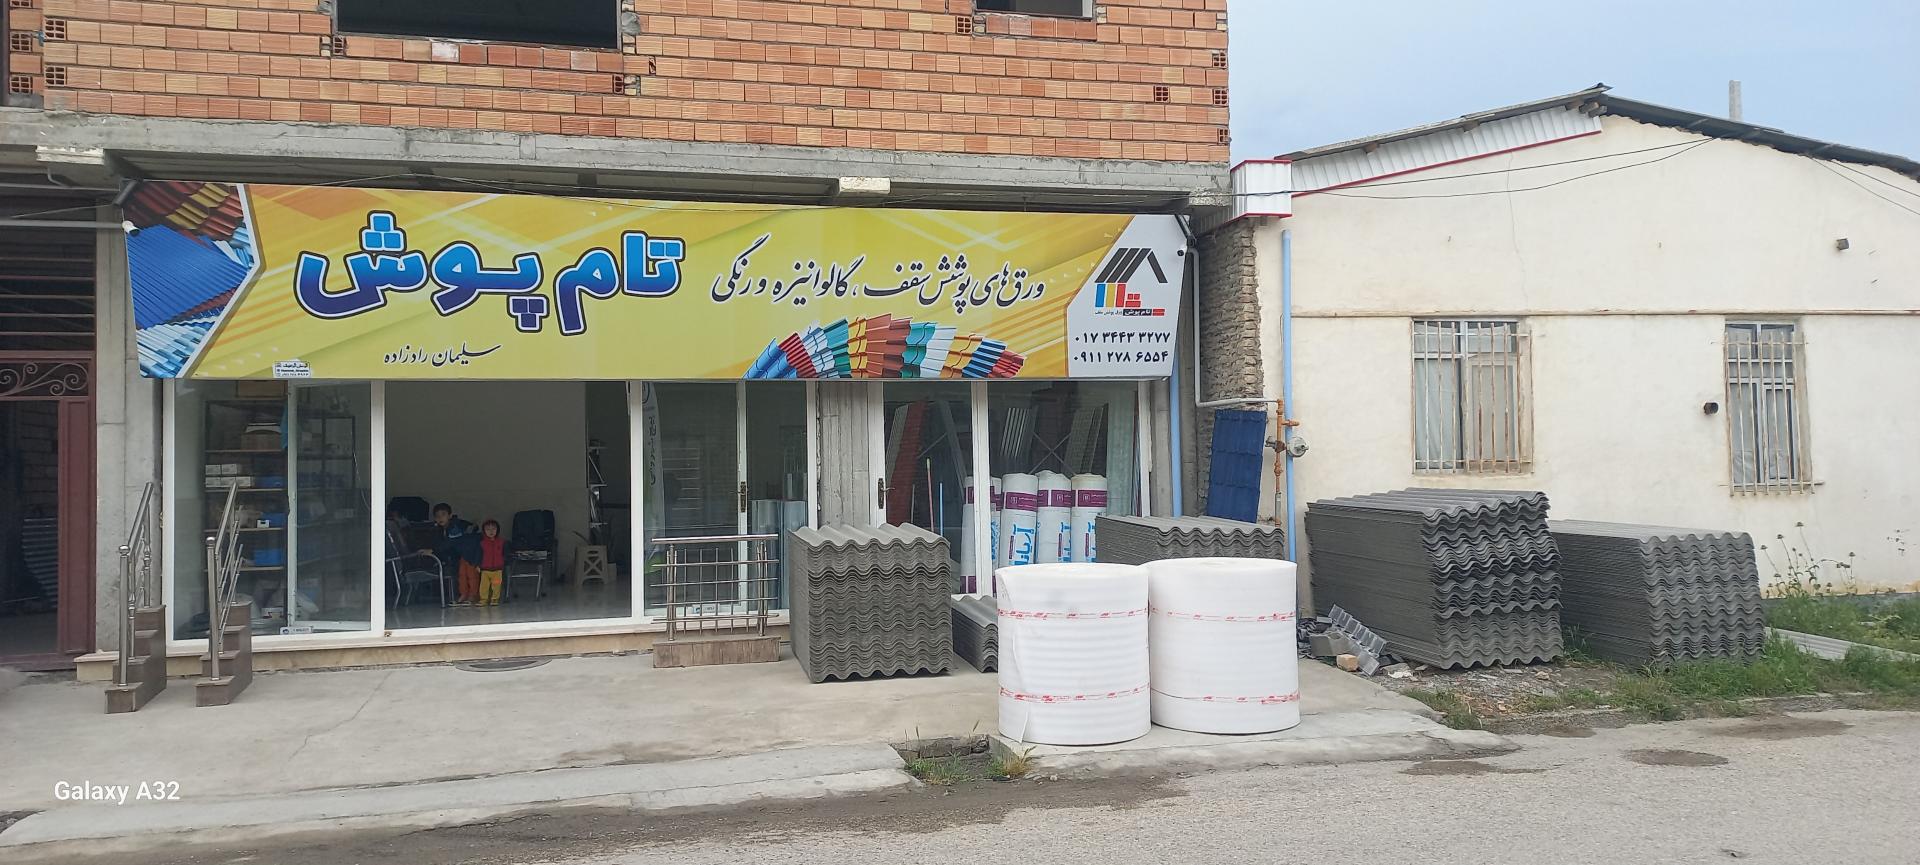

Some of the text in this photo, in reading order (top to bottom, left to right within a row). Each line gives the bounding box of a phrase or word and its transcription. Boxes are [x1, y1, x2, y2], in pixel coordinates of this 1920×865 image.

[294, 210, 686, 335] تام پوش
[711, 234, 770, 303] رنگی
[773, 255, 864, 305] گالوانیزه
[919, 254, 968, 314] پوشش
[432, 342, 501, 367] سلیمان
[1074, 350, 1169, 363] ۰۹۱۱ ۲۷۸ ۶۵۵۴
[1075, 331, 1171, 343] ۰۱۷ ۳۴۴۳ ۳۲۷۷
